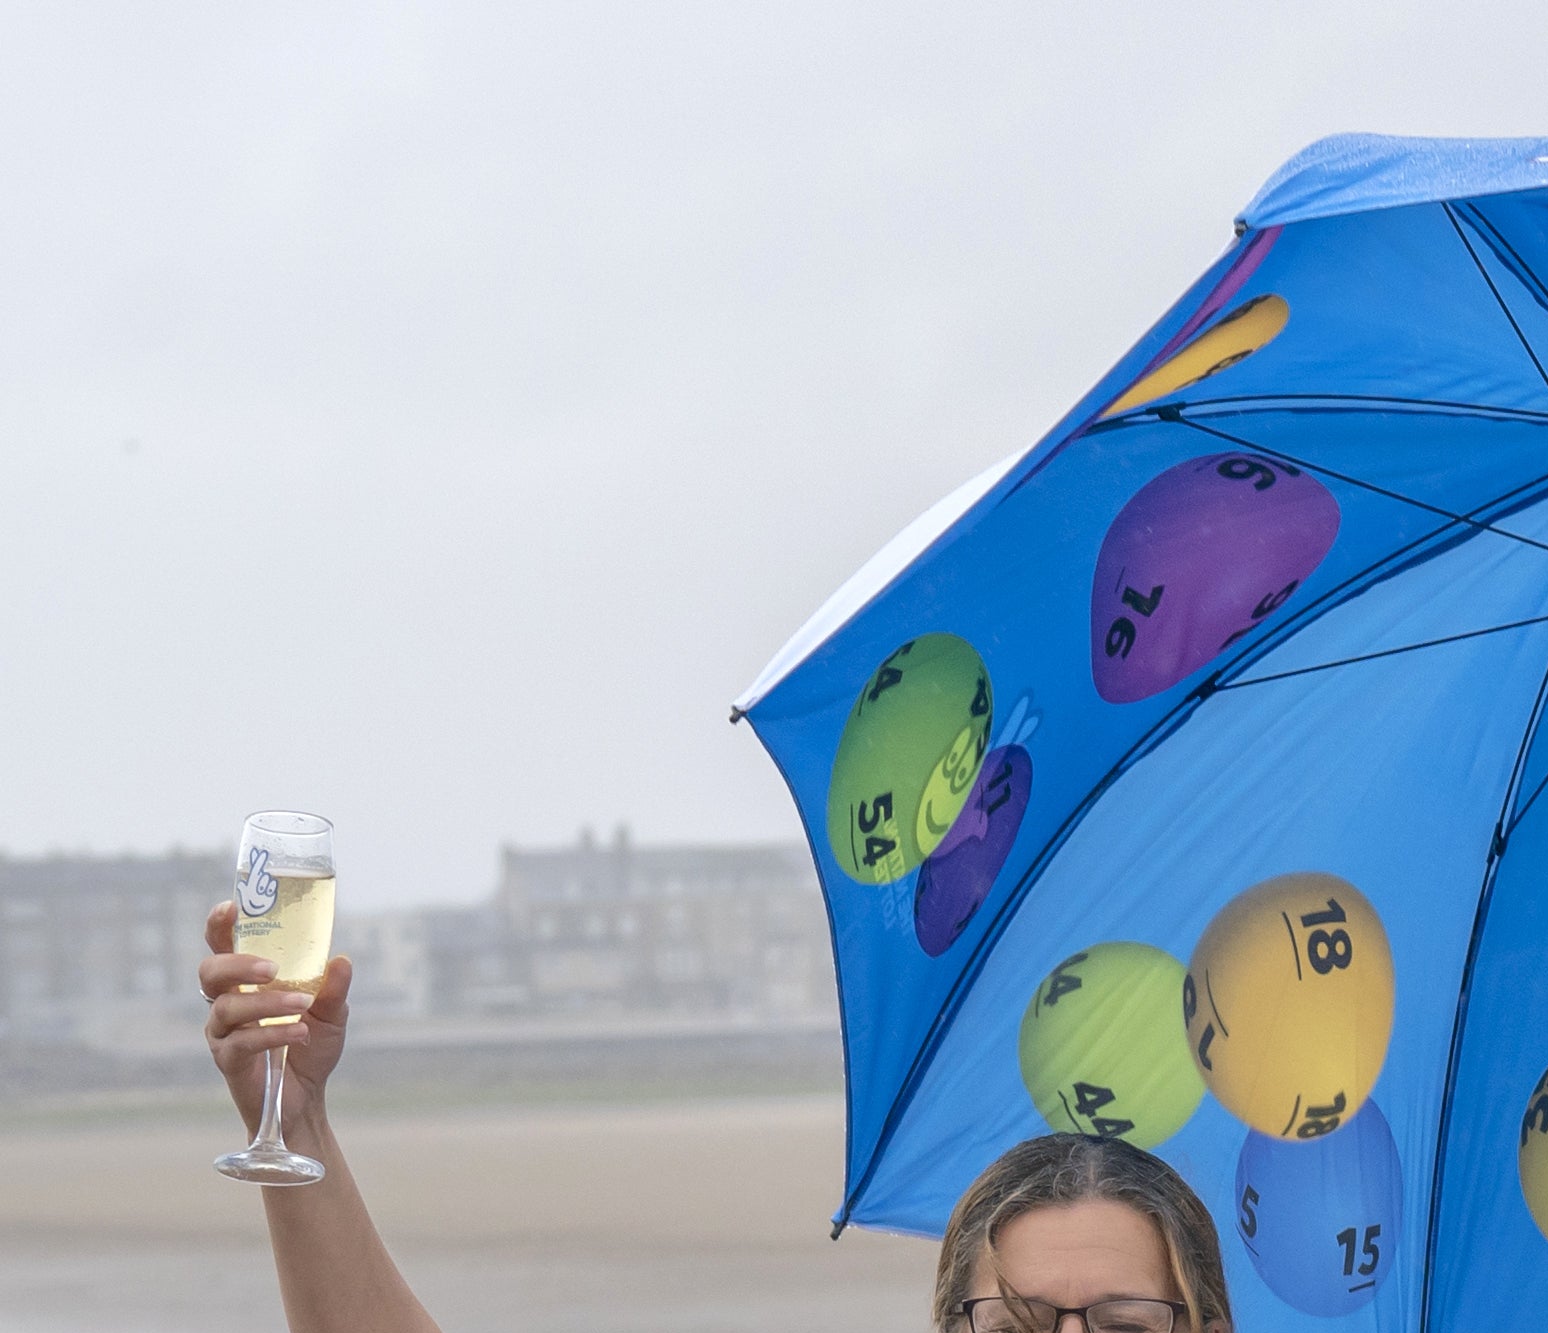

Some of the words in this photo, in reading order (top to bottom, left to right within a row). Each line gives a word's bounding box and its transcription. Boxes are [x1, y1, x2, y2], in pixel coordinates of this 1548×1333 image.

[857, 790, 897, 869] 54
[1300, 897, 1353, 976] 18
[1335, 1223, 1382, 1278] 15
